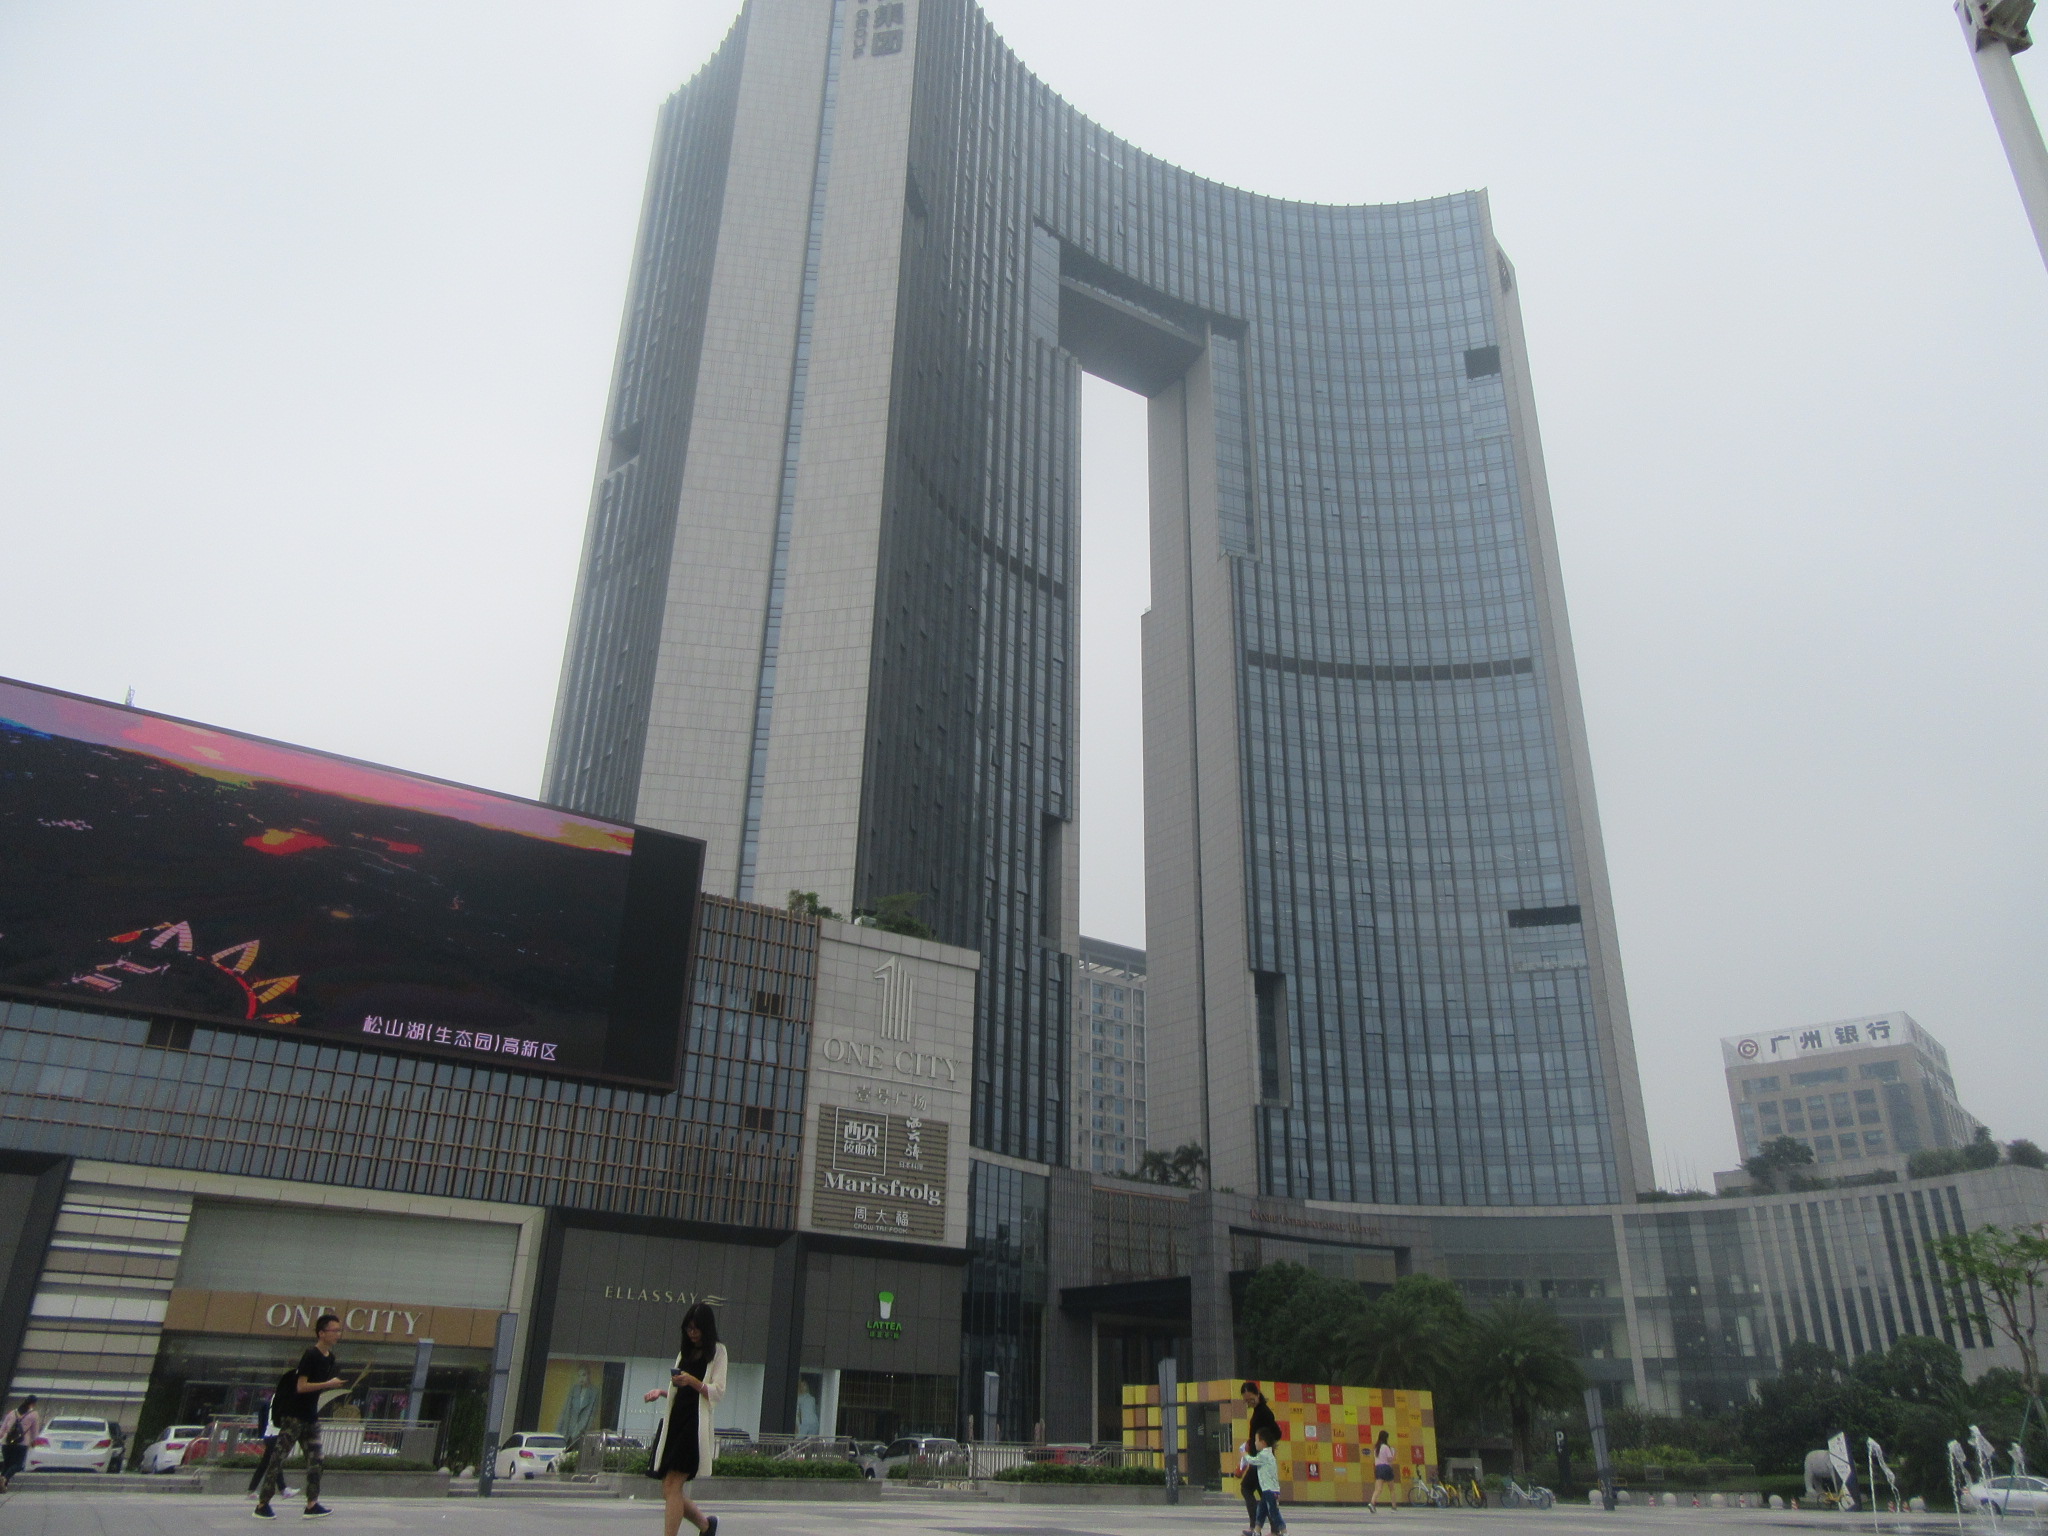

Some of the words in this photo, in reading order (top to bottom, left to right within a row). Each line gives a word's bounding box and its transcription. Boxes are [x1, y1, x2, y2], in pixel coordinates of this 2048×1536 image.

[362, 1014, 559, 1061] 松山湖(生态园)高新区
[1770, 1020, 1891, 1054] 广州银行
[822, 1037, 884, 1070] ONE
[895, 1049, 961, 1082] CITY
[856, 1084, 927, 1111] 壹号广场
[843, 1119, 879, 1145] 西贝
[823, 1172, 941, 1206] Marisfrolg
[853, 1223, 874, 1231] CHOW
[889, 1227, 909, 1235] FOOK
[854, 1206, 909, 1227] 周大福
[605, 1285, 699, 1305] ELLASSAY
[346, 1306, 423, 1335] CITY
[866, 1320, 902, 1331] LATTEA
[1556, 1431, 1565, 1446] P
